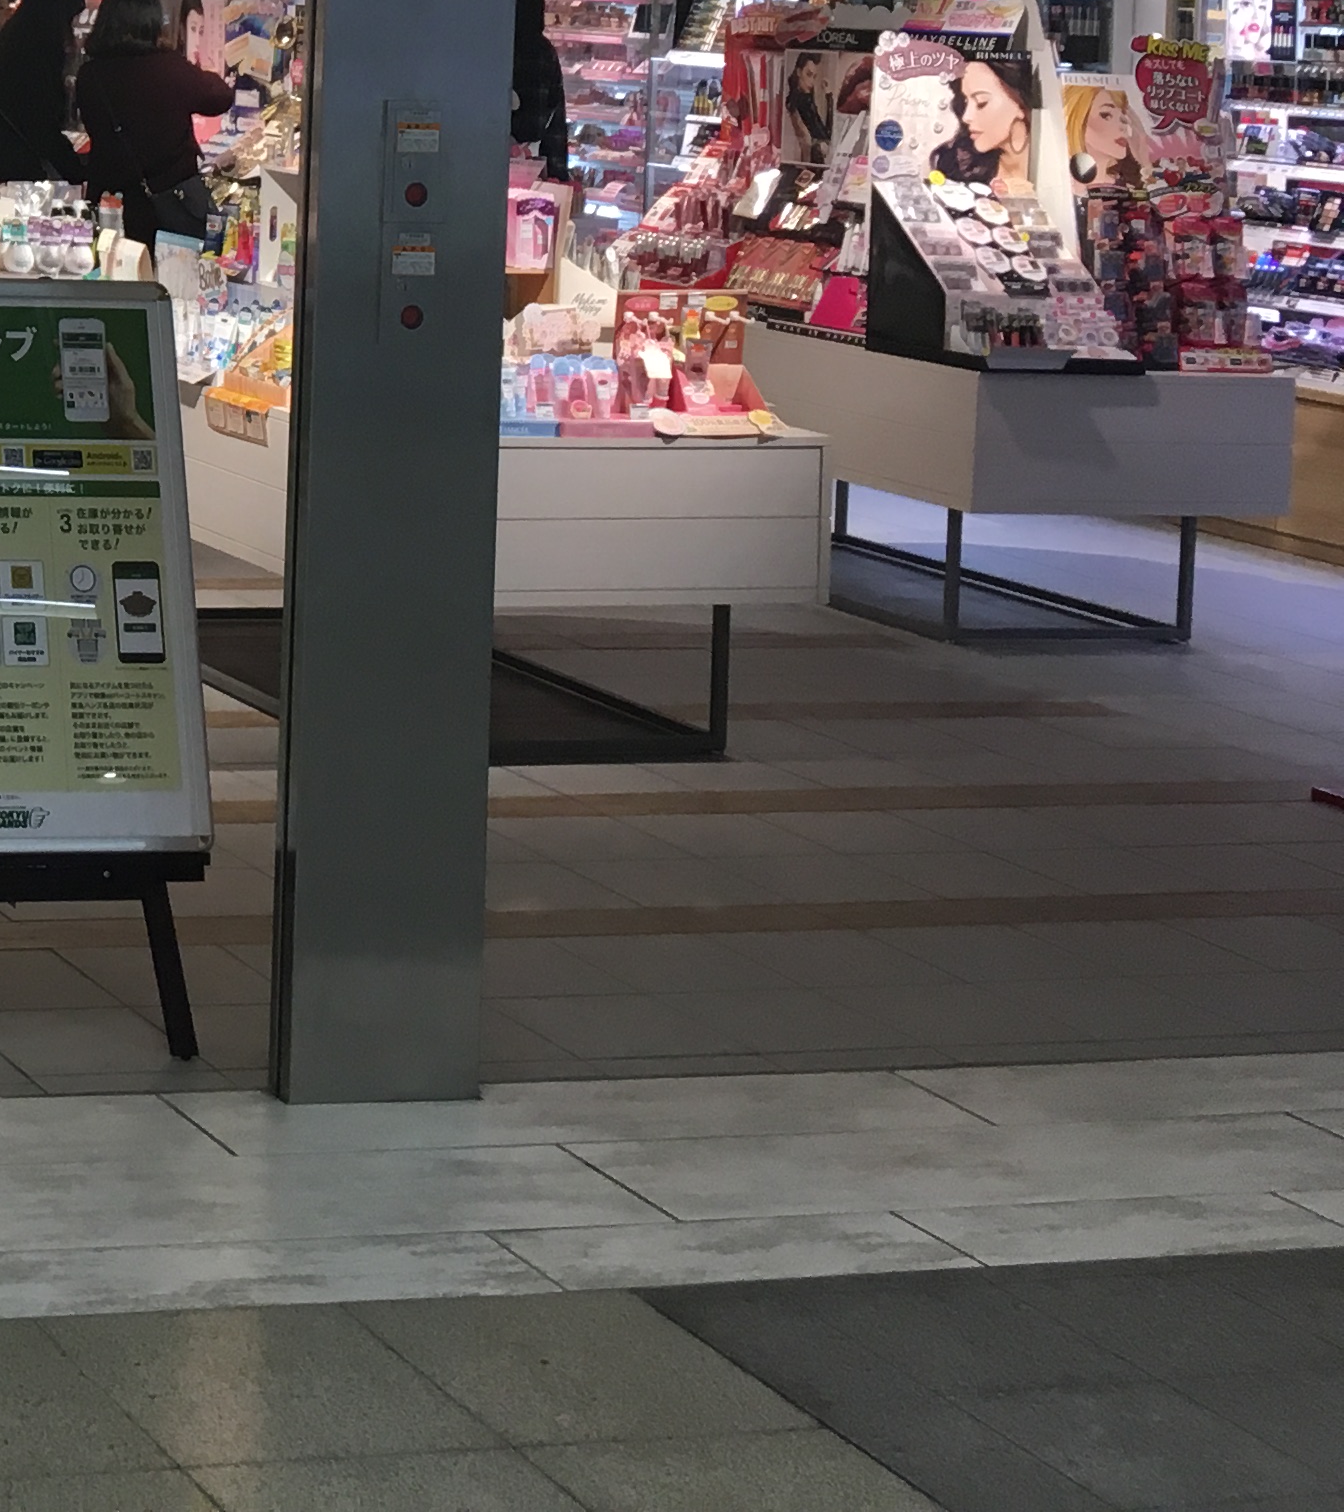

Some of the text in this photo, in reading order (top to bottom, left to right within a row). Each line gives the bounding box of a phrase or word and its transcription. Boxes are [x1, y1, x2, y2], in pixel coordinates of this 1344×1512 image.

[1182, 42, 1209, 61] ME
[888, 51, 961, 71] 極上のツヤ
[1064, 75, 1121, 86] RIMMEL
[76, 507, 152, 520] 在庫が分かる！
[60, 514, 72, 533] 3
[77, 523, 146, 535] お取り寄せが
[78, 539, 120, 551] できる！
